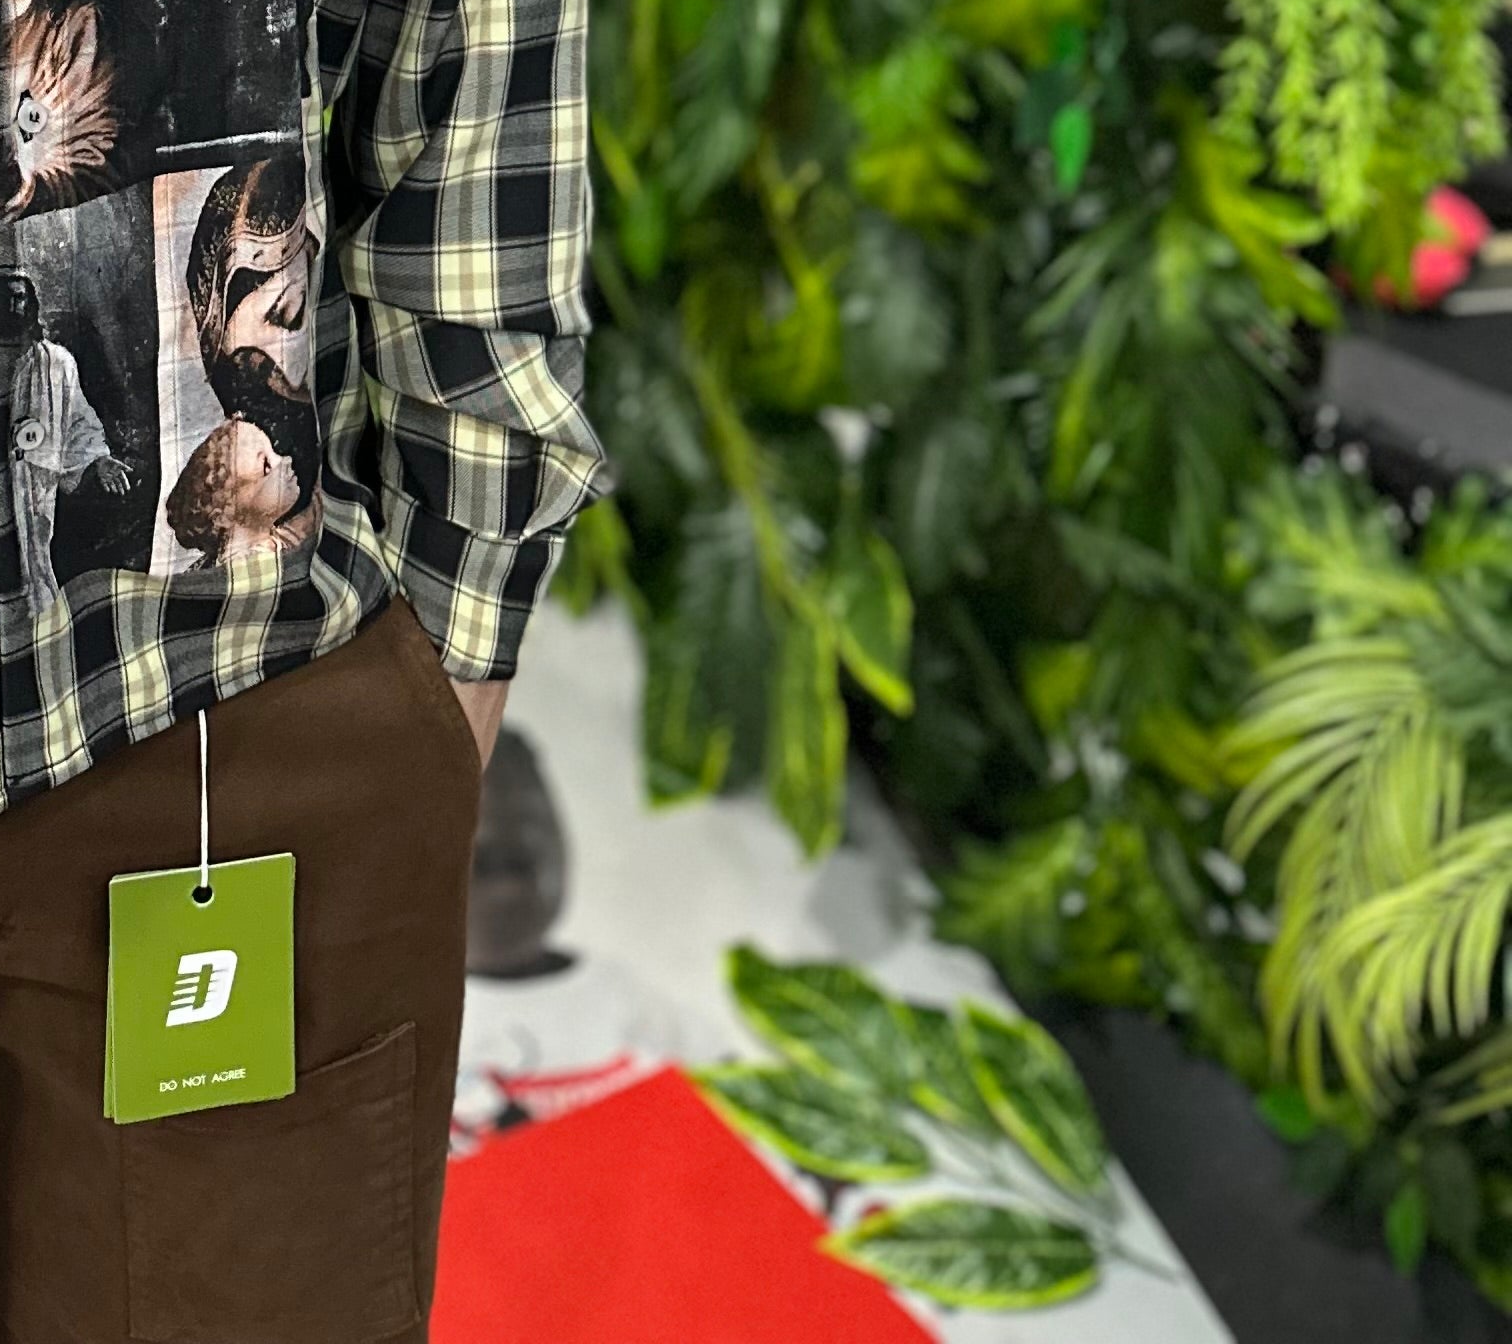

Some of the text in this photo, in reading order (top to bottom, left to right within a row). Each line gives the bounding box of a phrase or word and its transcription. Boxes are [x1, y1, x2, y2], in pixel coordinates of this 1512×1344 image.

[159, 1068, 246, 1093] DO NOT AGREE
